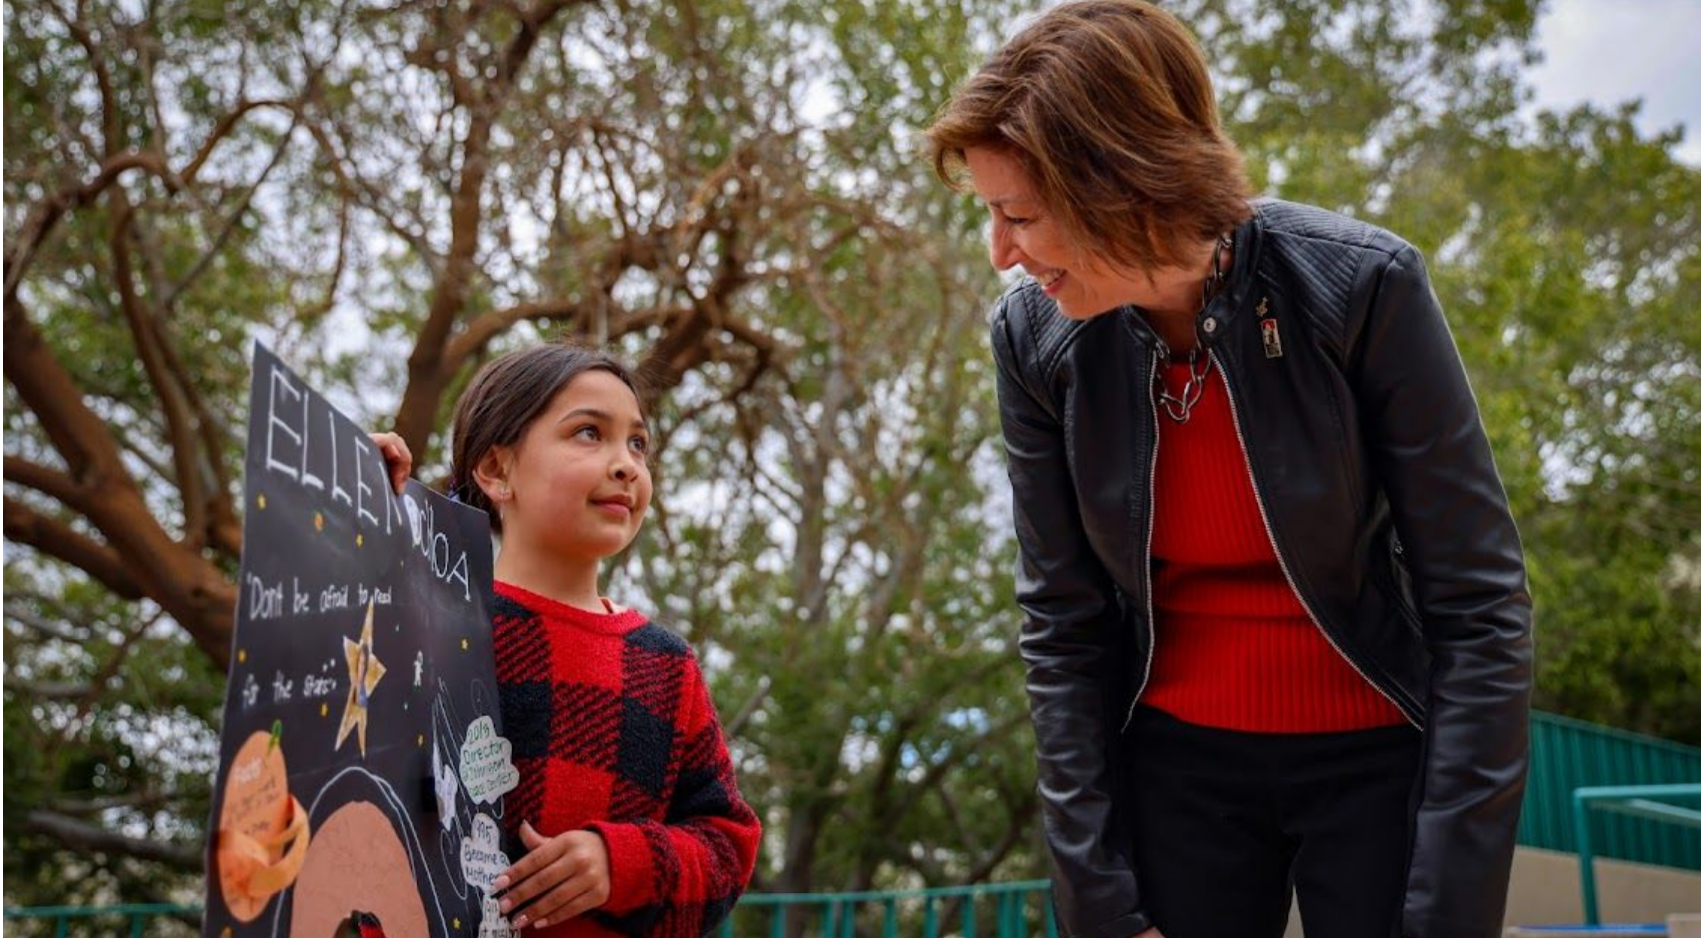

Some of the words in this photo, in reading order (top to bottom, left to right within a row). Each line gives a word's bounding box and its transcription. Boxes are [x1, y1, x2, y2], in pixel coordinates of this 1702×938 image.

[293, 576, 310, 614] be
[320, 584, 349, 613] afraid
[358, 582, 369, 607] to
[272, 669, 294, 704] the
[463, 740, 508, 765] Director
